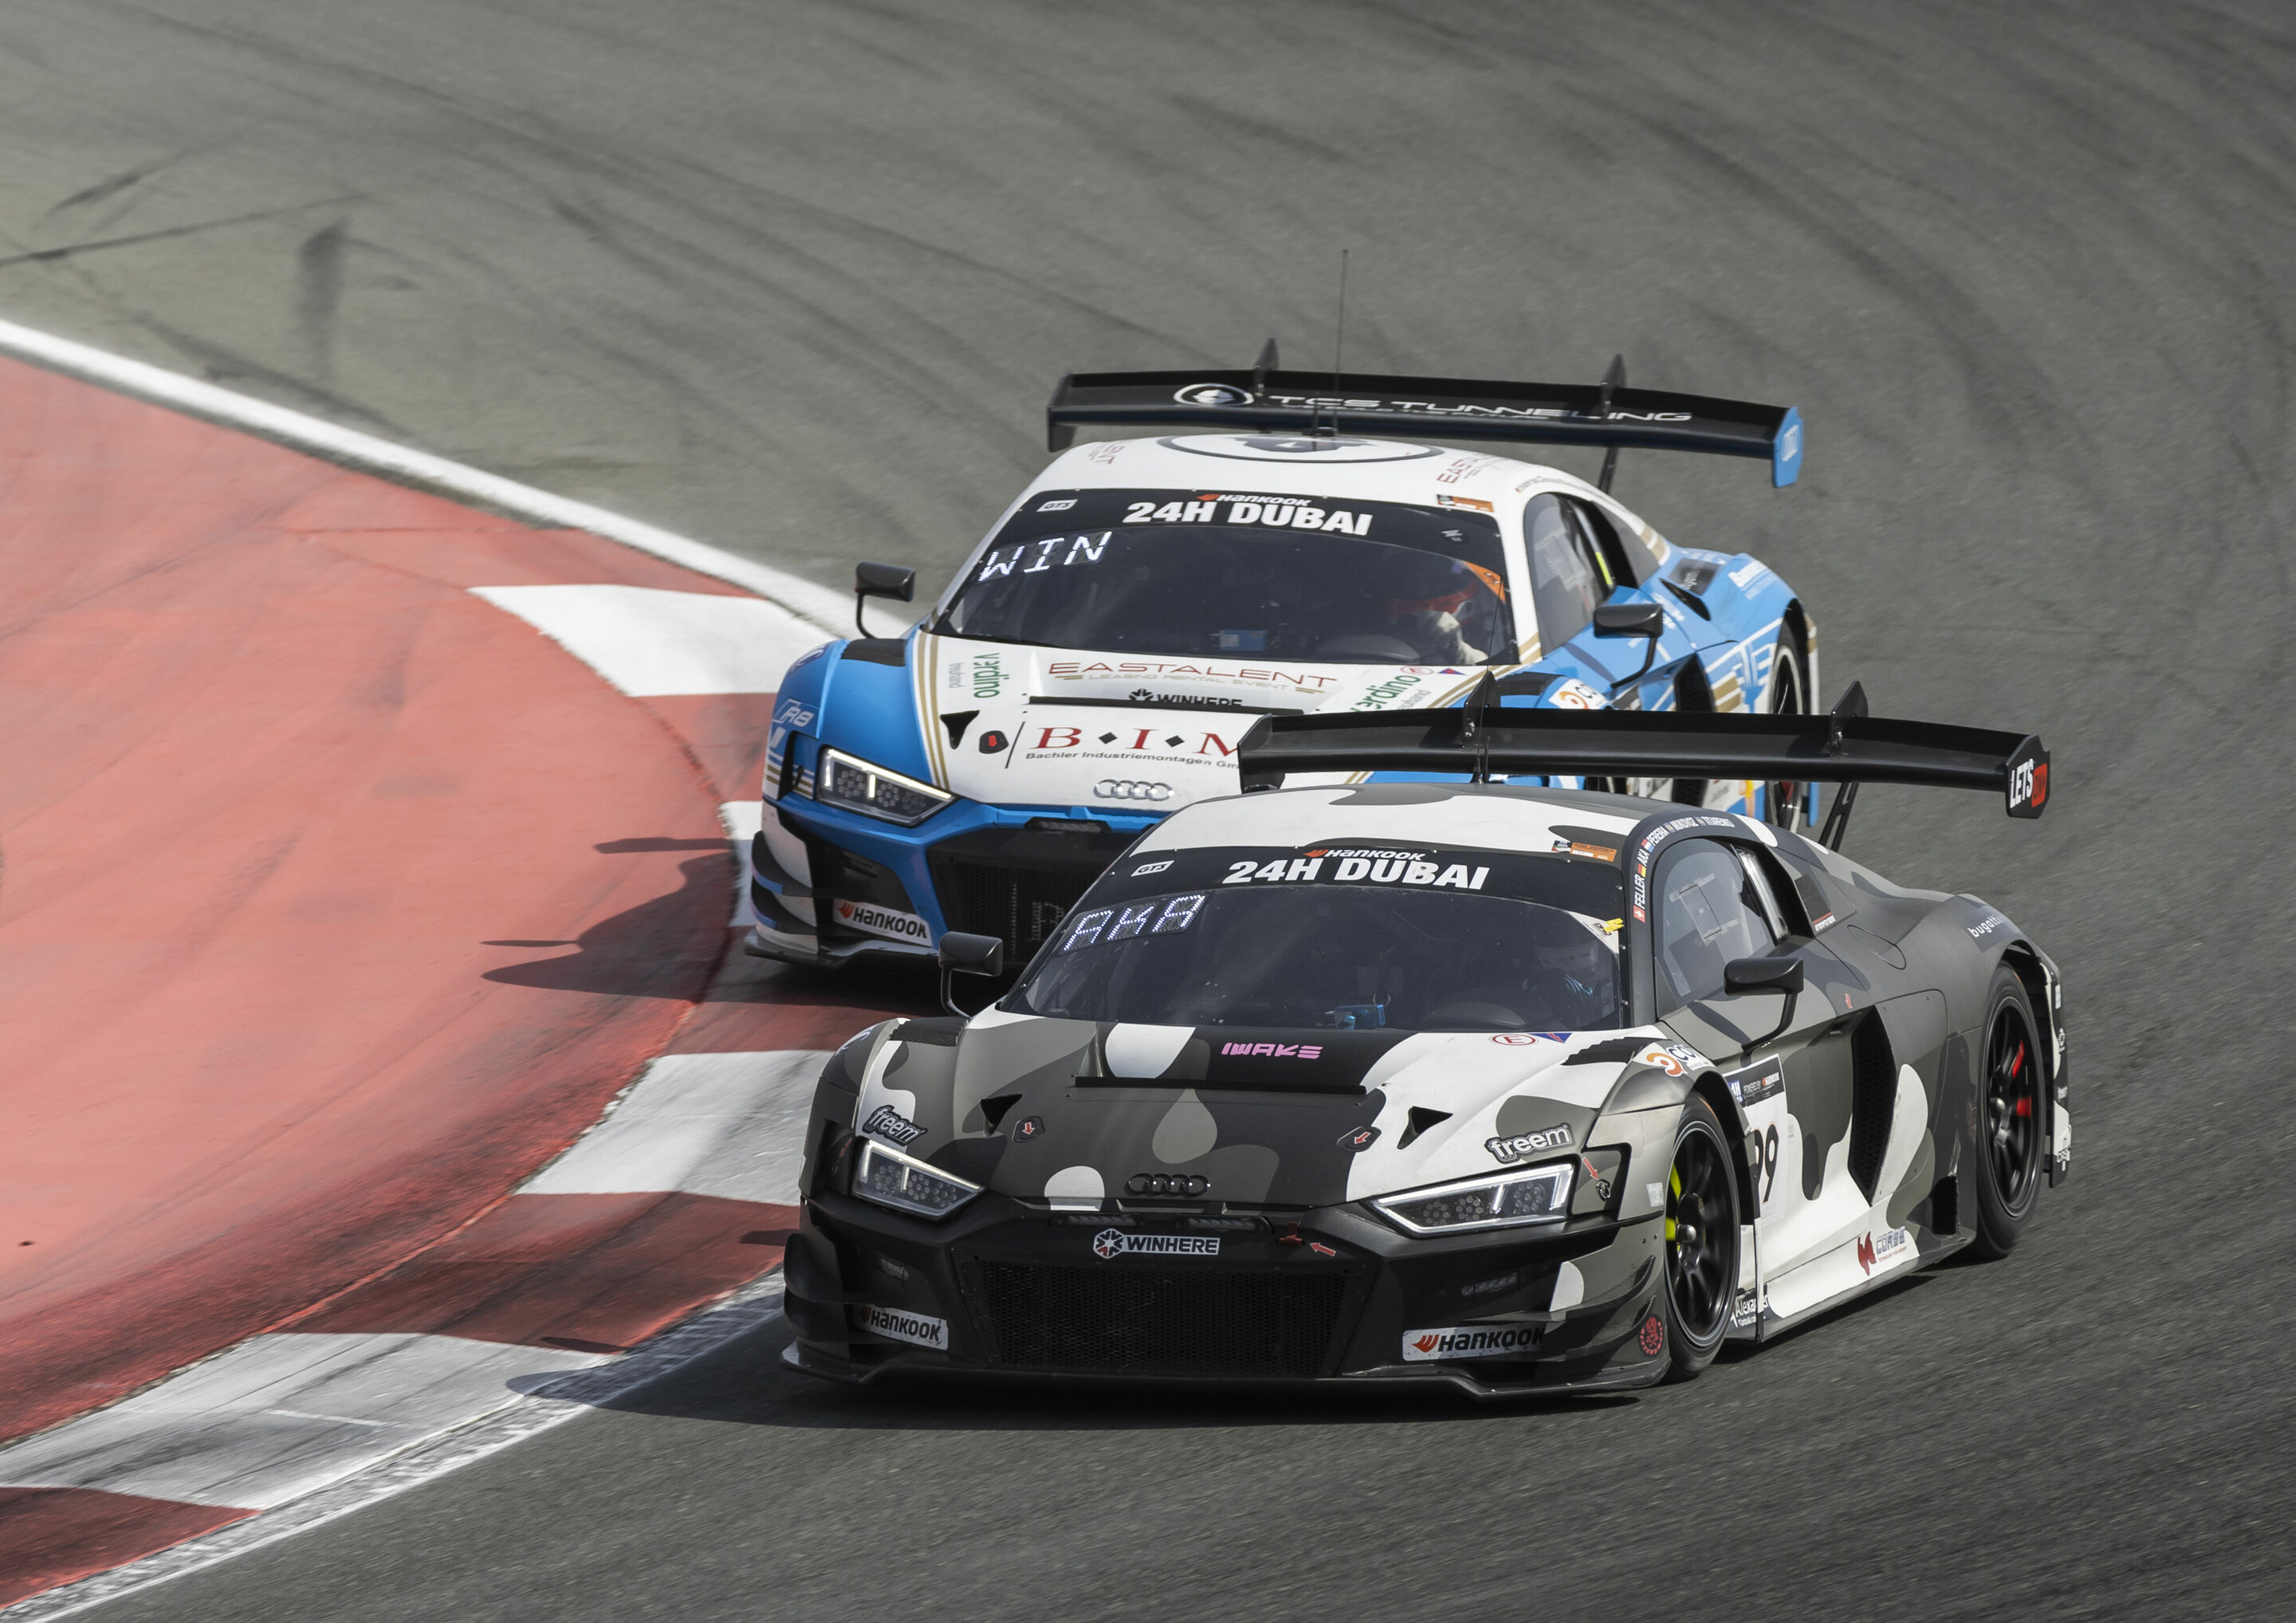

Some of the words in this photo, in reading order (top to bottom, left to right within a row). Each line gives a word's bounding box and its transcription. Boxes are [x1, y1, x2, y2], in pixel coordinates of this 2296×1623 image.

[1122, 501, 1217, 523] 24H
[1228, 502, 1373, 536] DUBAI
[978, 531, 1112, 582] WIN
[1049, 662, 1337, 687] EASTALENT
[1083, 752, 1213, 765] Industriemontagen
[1216, 760, 1239, 769] Gm
[2010, 758, 2034, 808] LETS
[1637, 848, 1650, 867] AKA
[1222, 859, 1324, 884] 24H
[1334, 859, 1489, 890] DUBAI
[1634, 874, 1645, 910] FELLER
[1490, 1126, 1571, 1160] freem
[1126, 1236, 1219, 1254] WINHERE
